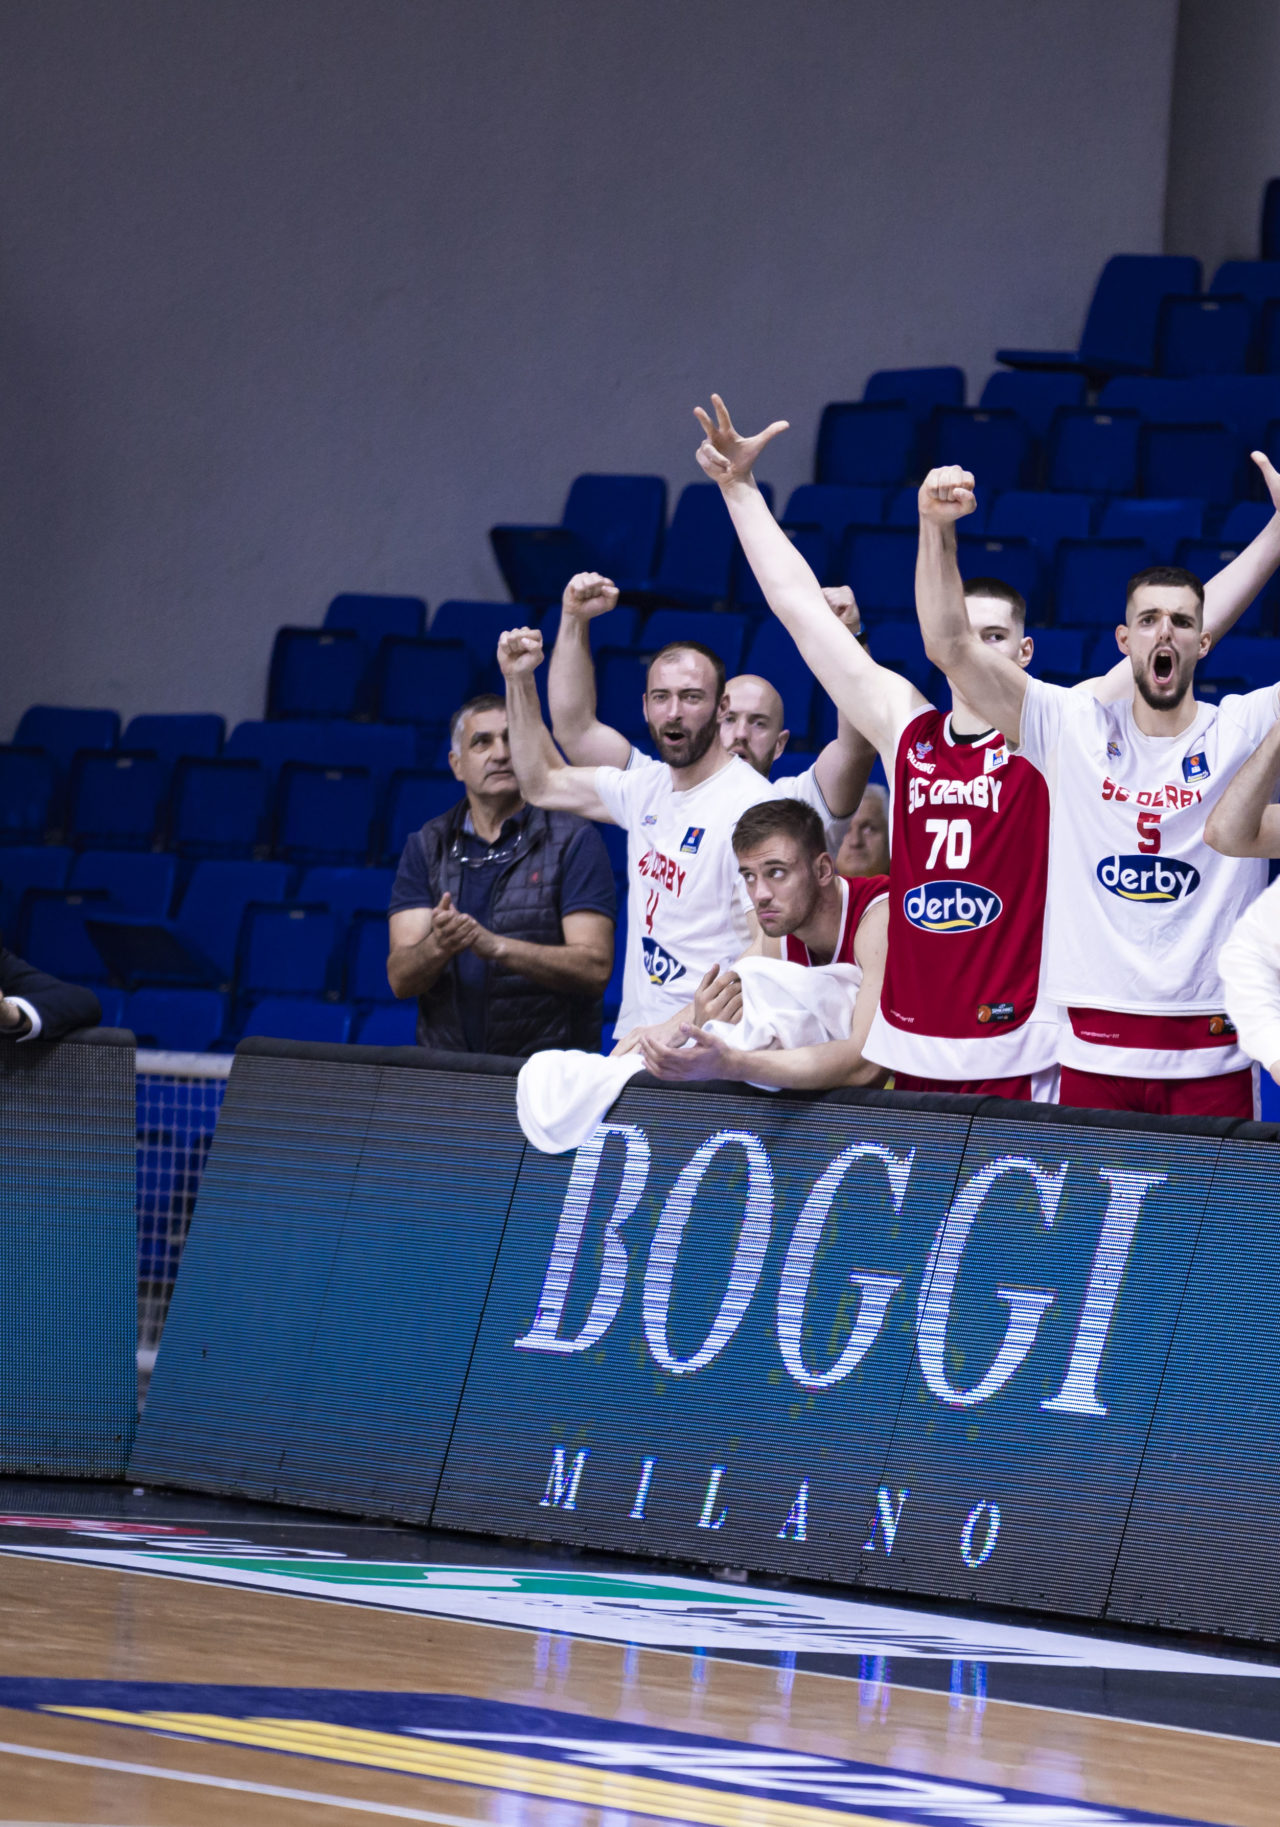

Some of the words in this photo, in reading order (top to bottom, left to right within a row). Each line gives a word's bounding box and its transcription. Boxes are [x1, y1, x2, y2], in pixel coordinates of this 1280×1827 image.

[908, 776, 931, 814] SC
[929, 775, 1002, 813] DERBY
[925, 818, 972, 870] 70
[1136, 812, 1163, 855] 5
[1101, 855, 1195, 900] derby
[645, 889, 660, 935] 4
[907, 885, 995, 927] derby
[514, 1122, 1169, 1416] BOGGI
[539, 1445, 1000, 1568] MILANO
